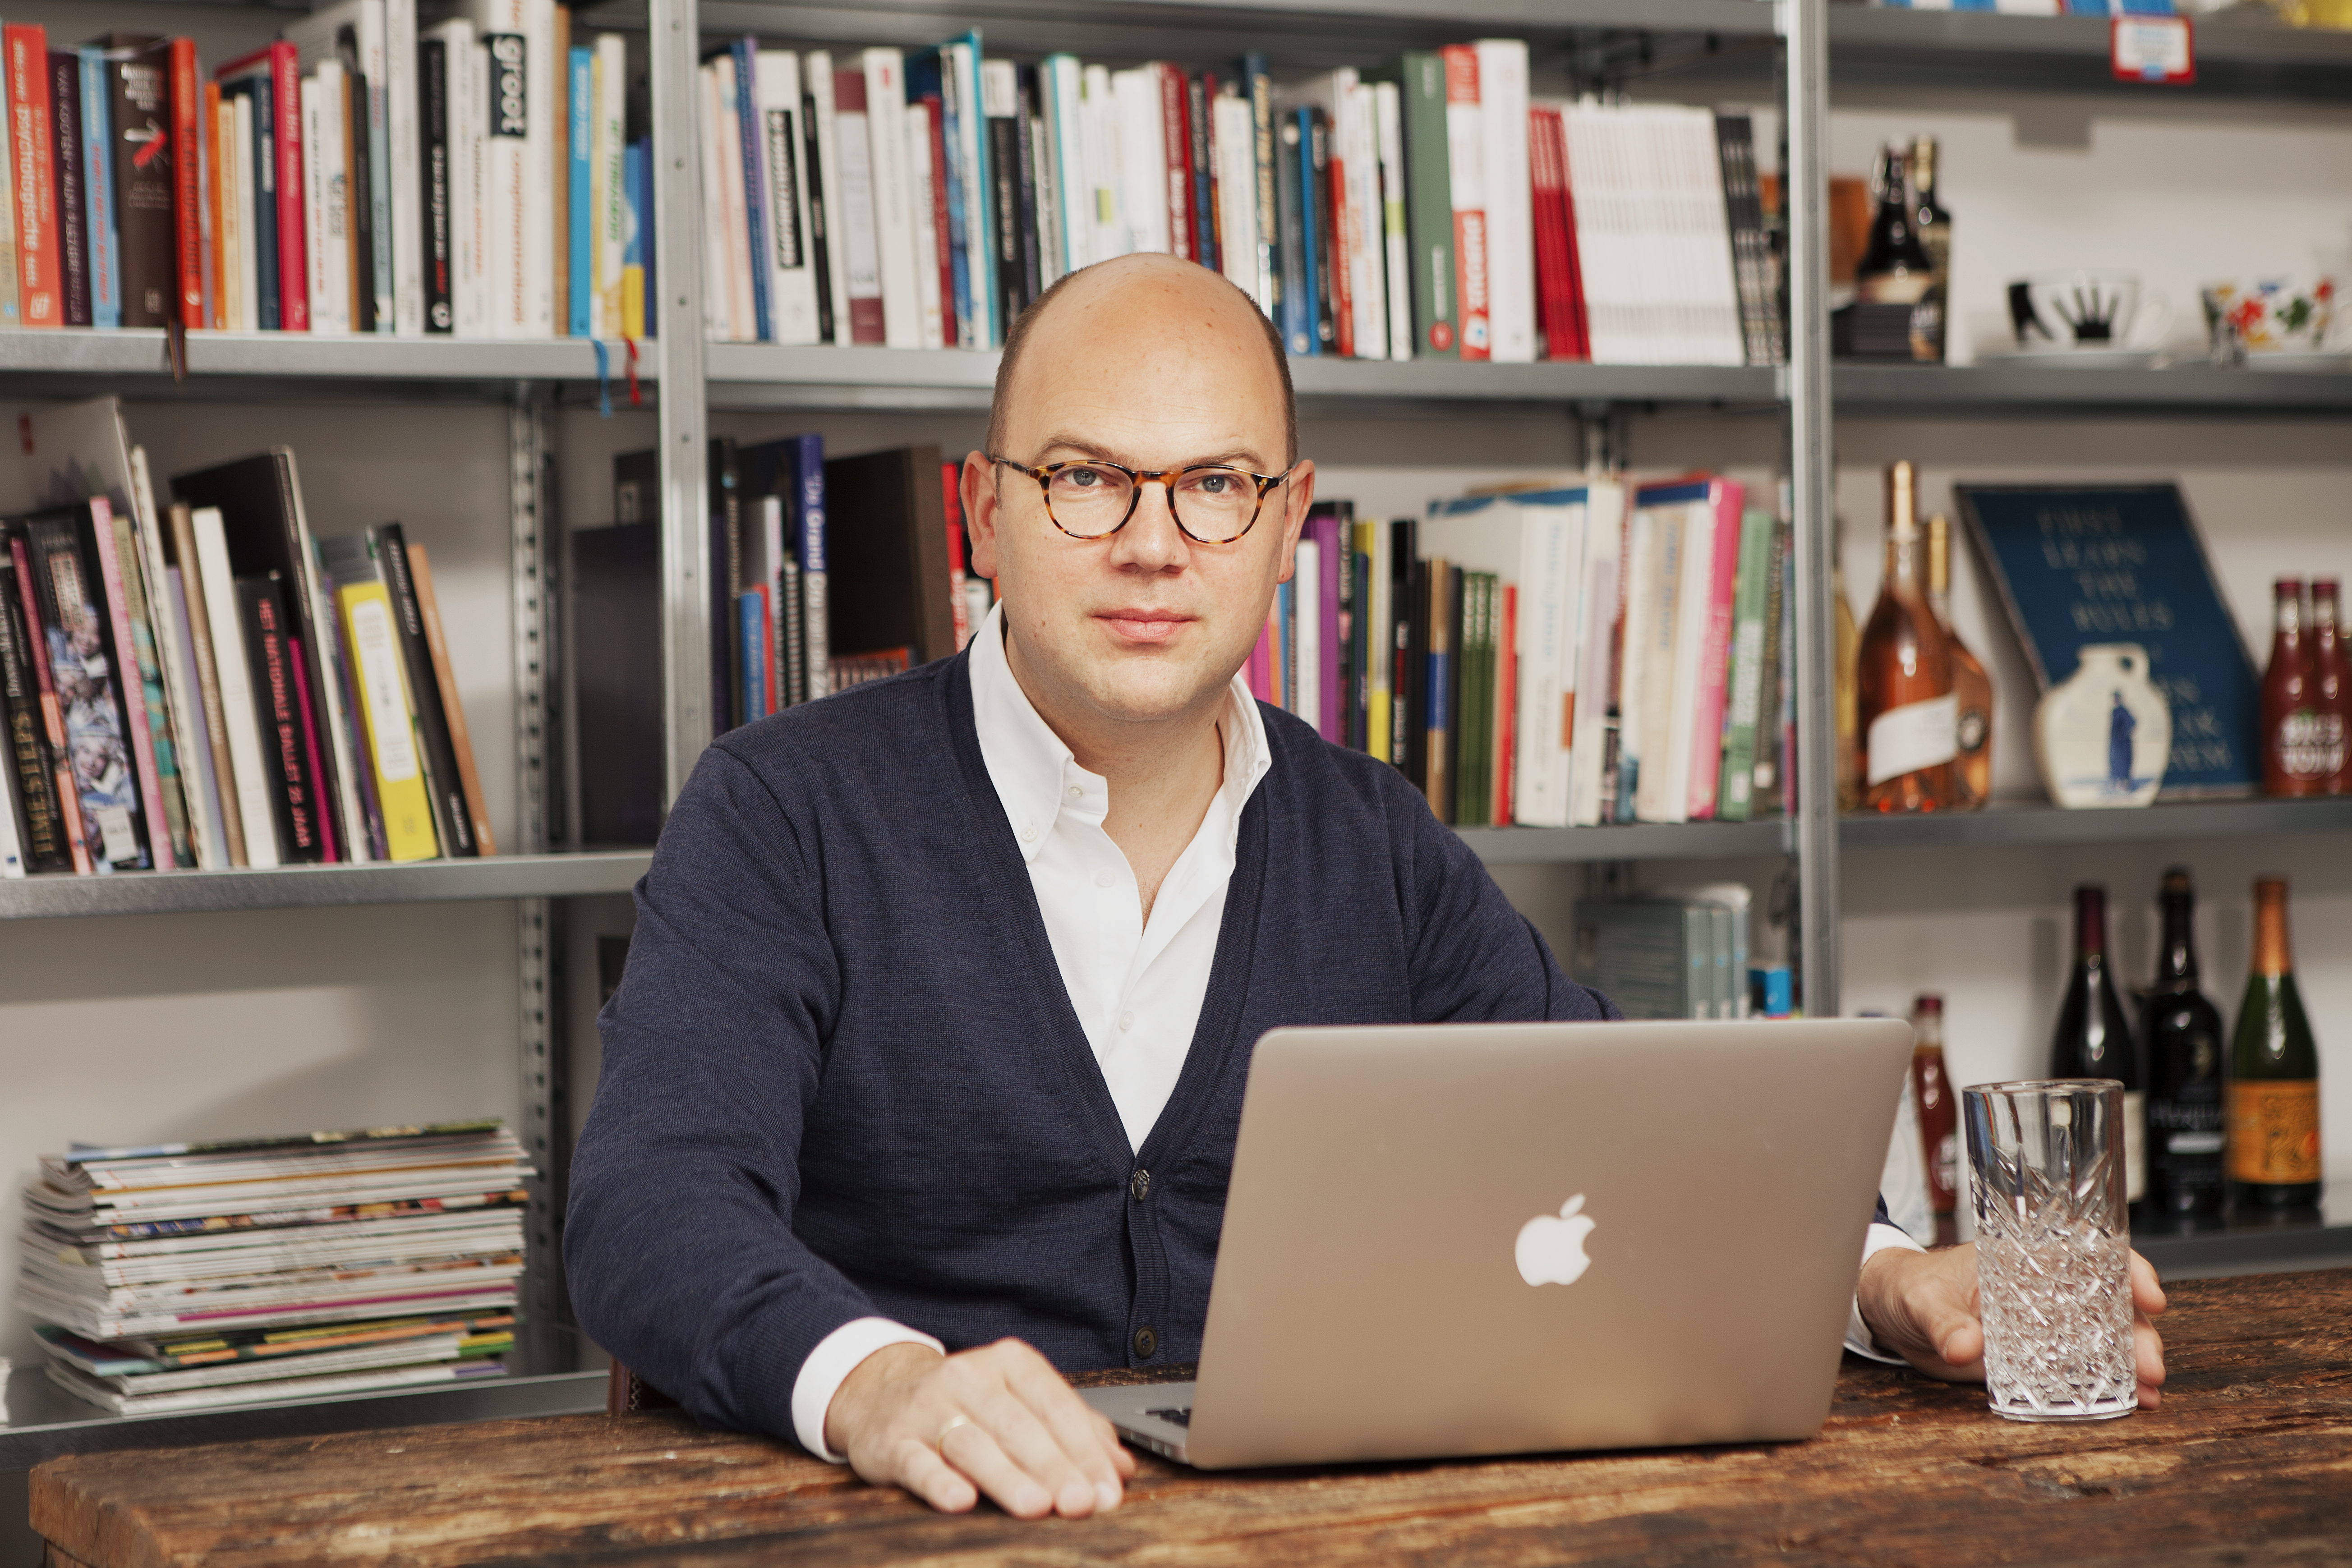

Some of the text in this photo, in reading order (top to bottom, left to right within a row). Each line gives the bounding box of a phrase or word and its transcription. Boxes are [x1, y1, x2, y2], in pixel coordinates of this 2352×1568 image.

[492, 36, 526, 135] groot
[15, 104, 38, 250] psychologische
[805, 508, 826, 571] Grand
[806, 571, 826, 608] Cru
[2071, 602, 2175, 631] RULES
[808, 610, 825, 644] van
[809, 647, 827, 671] de
[258, 598, 312, 848] HET NATIONALE BALLET 25 JAAR
[10, 710, 55, 857] TIME STEPS
